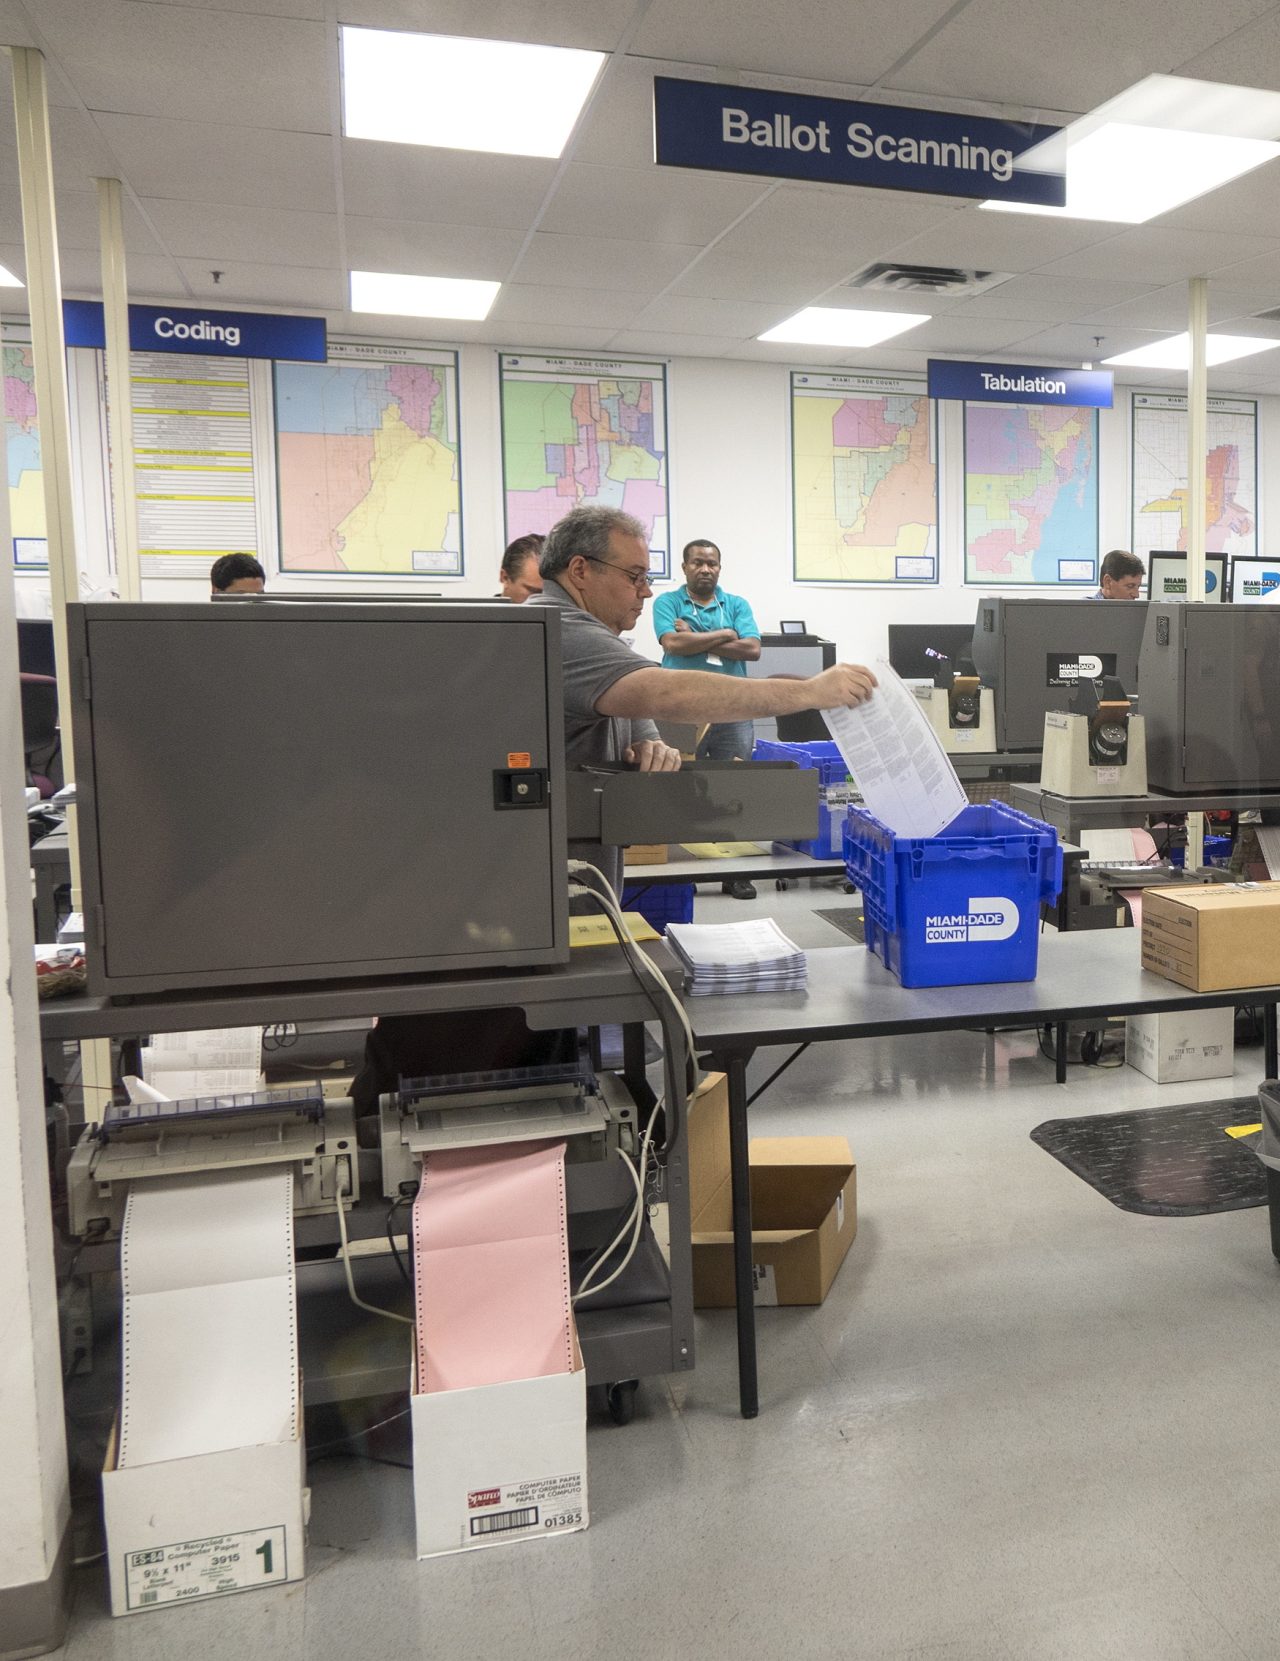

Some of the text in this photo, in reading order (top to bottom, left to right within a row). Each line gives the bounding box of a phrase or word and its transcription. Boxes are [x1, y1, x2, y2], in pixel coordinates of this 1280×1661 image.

[721, 107, 1014, 182] Ballot Scanning
[154, 316, 241, 346] Coding
[981, 372, 1067, 395] Tabulation
[926, 914, 1002, 927] MIAMI-DADE
[927, 929, 966, 940] COUNTY
[519, 1475, 580, 1490] COMPUTER PAPER
[506, 1490, 530, 1498] PAPIER
[516, 1495, 536, 1503] PAPEL
[544, 1513, 582, 1528] 01385
[183, 1537, 224, 1550] Recycled
[167, 1547, 211, 1560] Computer
[213, 1542, 240, 1553] Paper
[255, 1539, 273, 1574] 1
[211, 1553, 240, 1566] 3915
[176, 1586, 200, 1597] 2400
